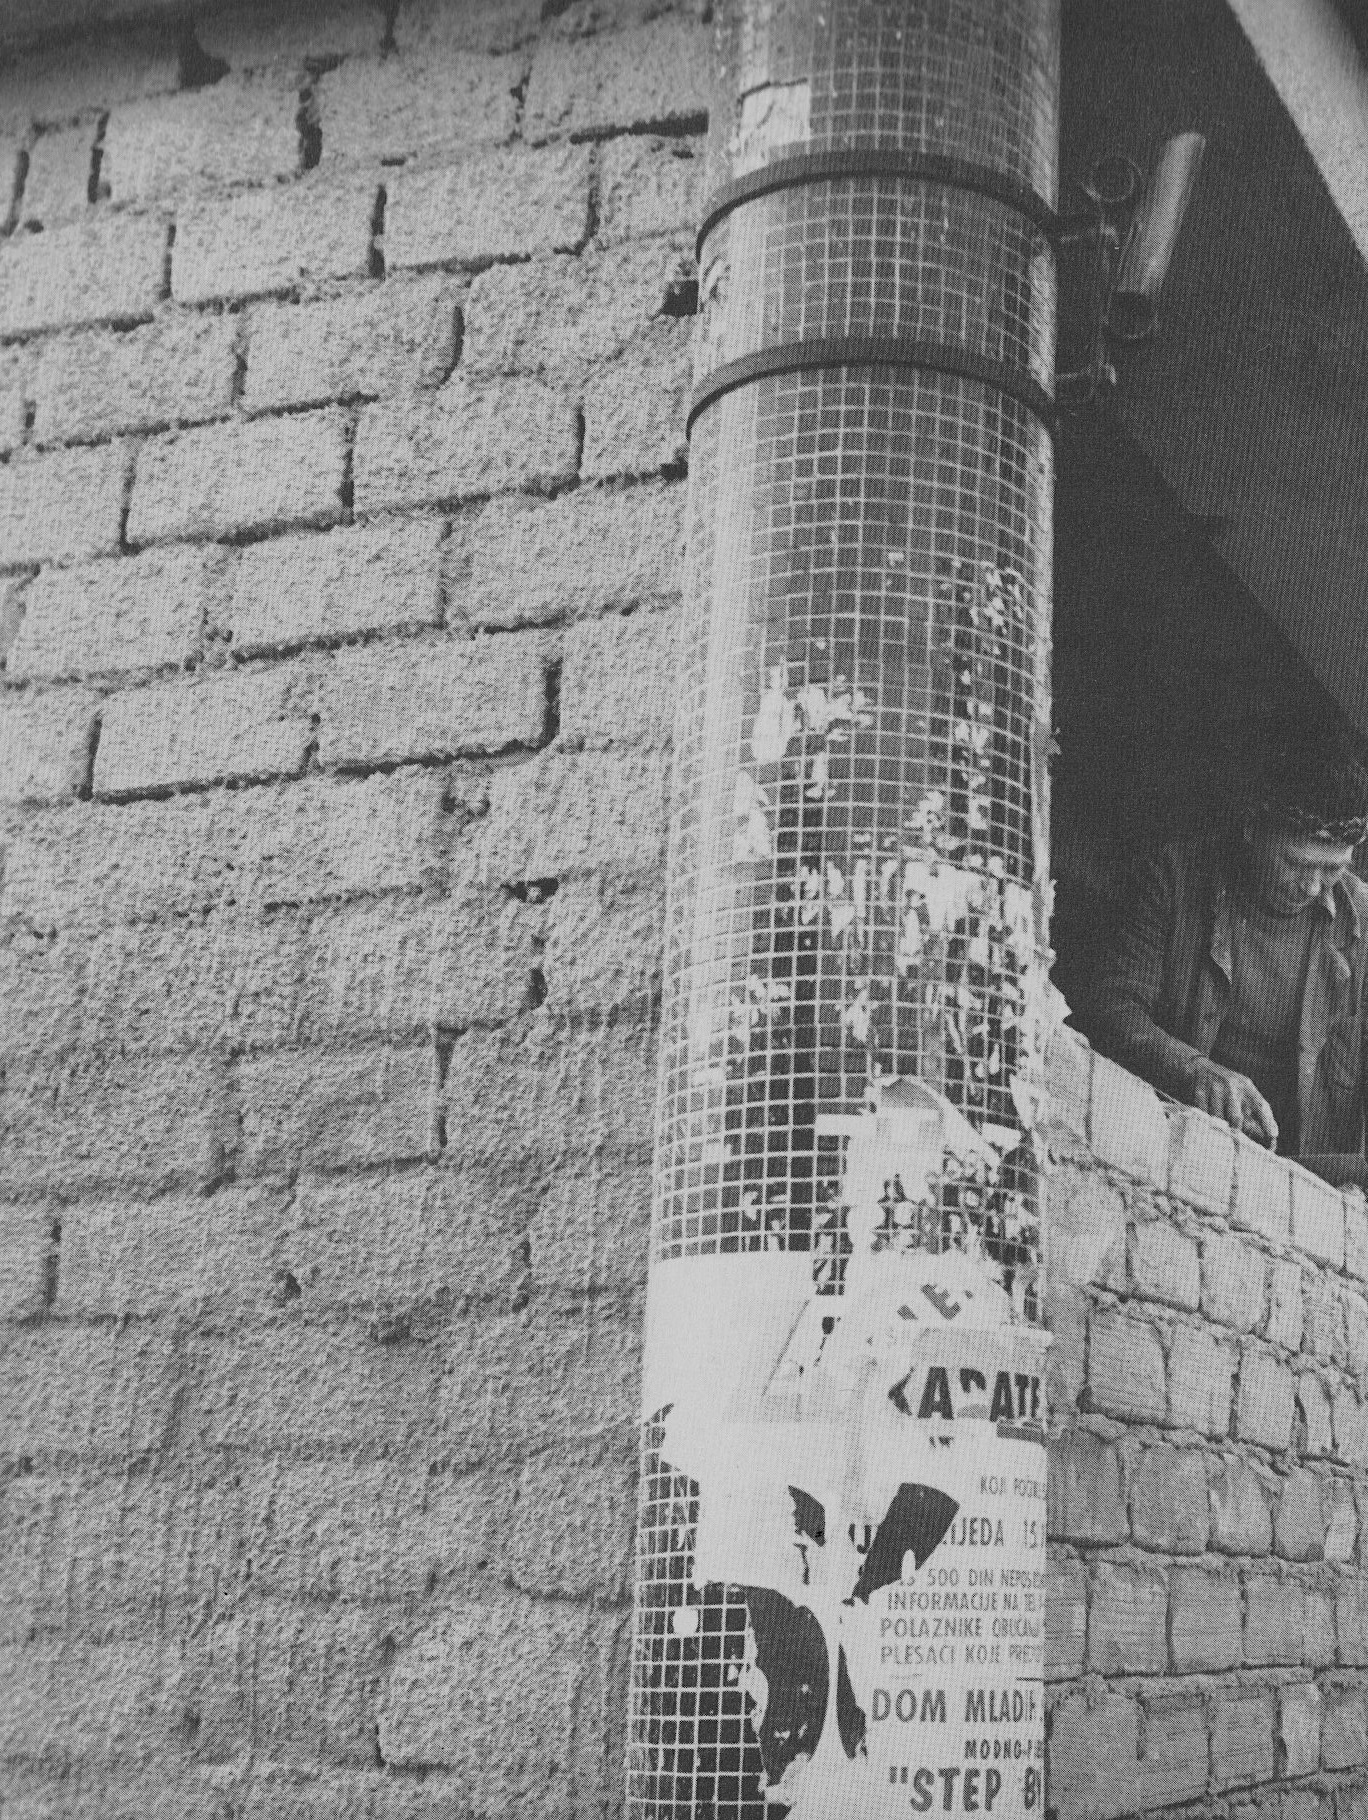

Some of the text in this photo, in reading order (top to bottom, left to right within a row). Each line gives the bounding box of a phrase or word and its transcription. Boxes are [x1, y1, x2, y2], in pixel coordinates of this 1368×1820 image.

[927, 1568, 960, 1587] 500
[968, 1568, 994, 1587] DIN
[887, 1592, 998, 1611] INFORMACIJE
[880, 1617, 982, 1638] POLAZNIKE
[872, 1688, 947, 1723] DOM
